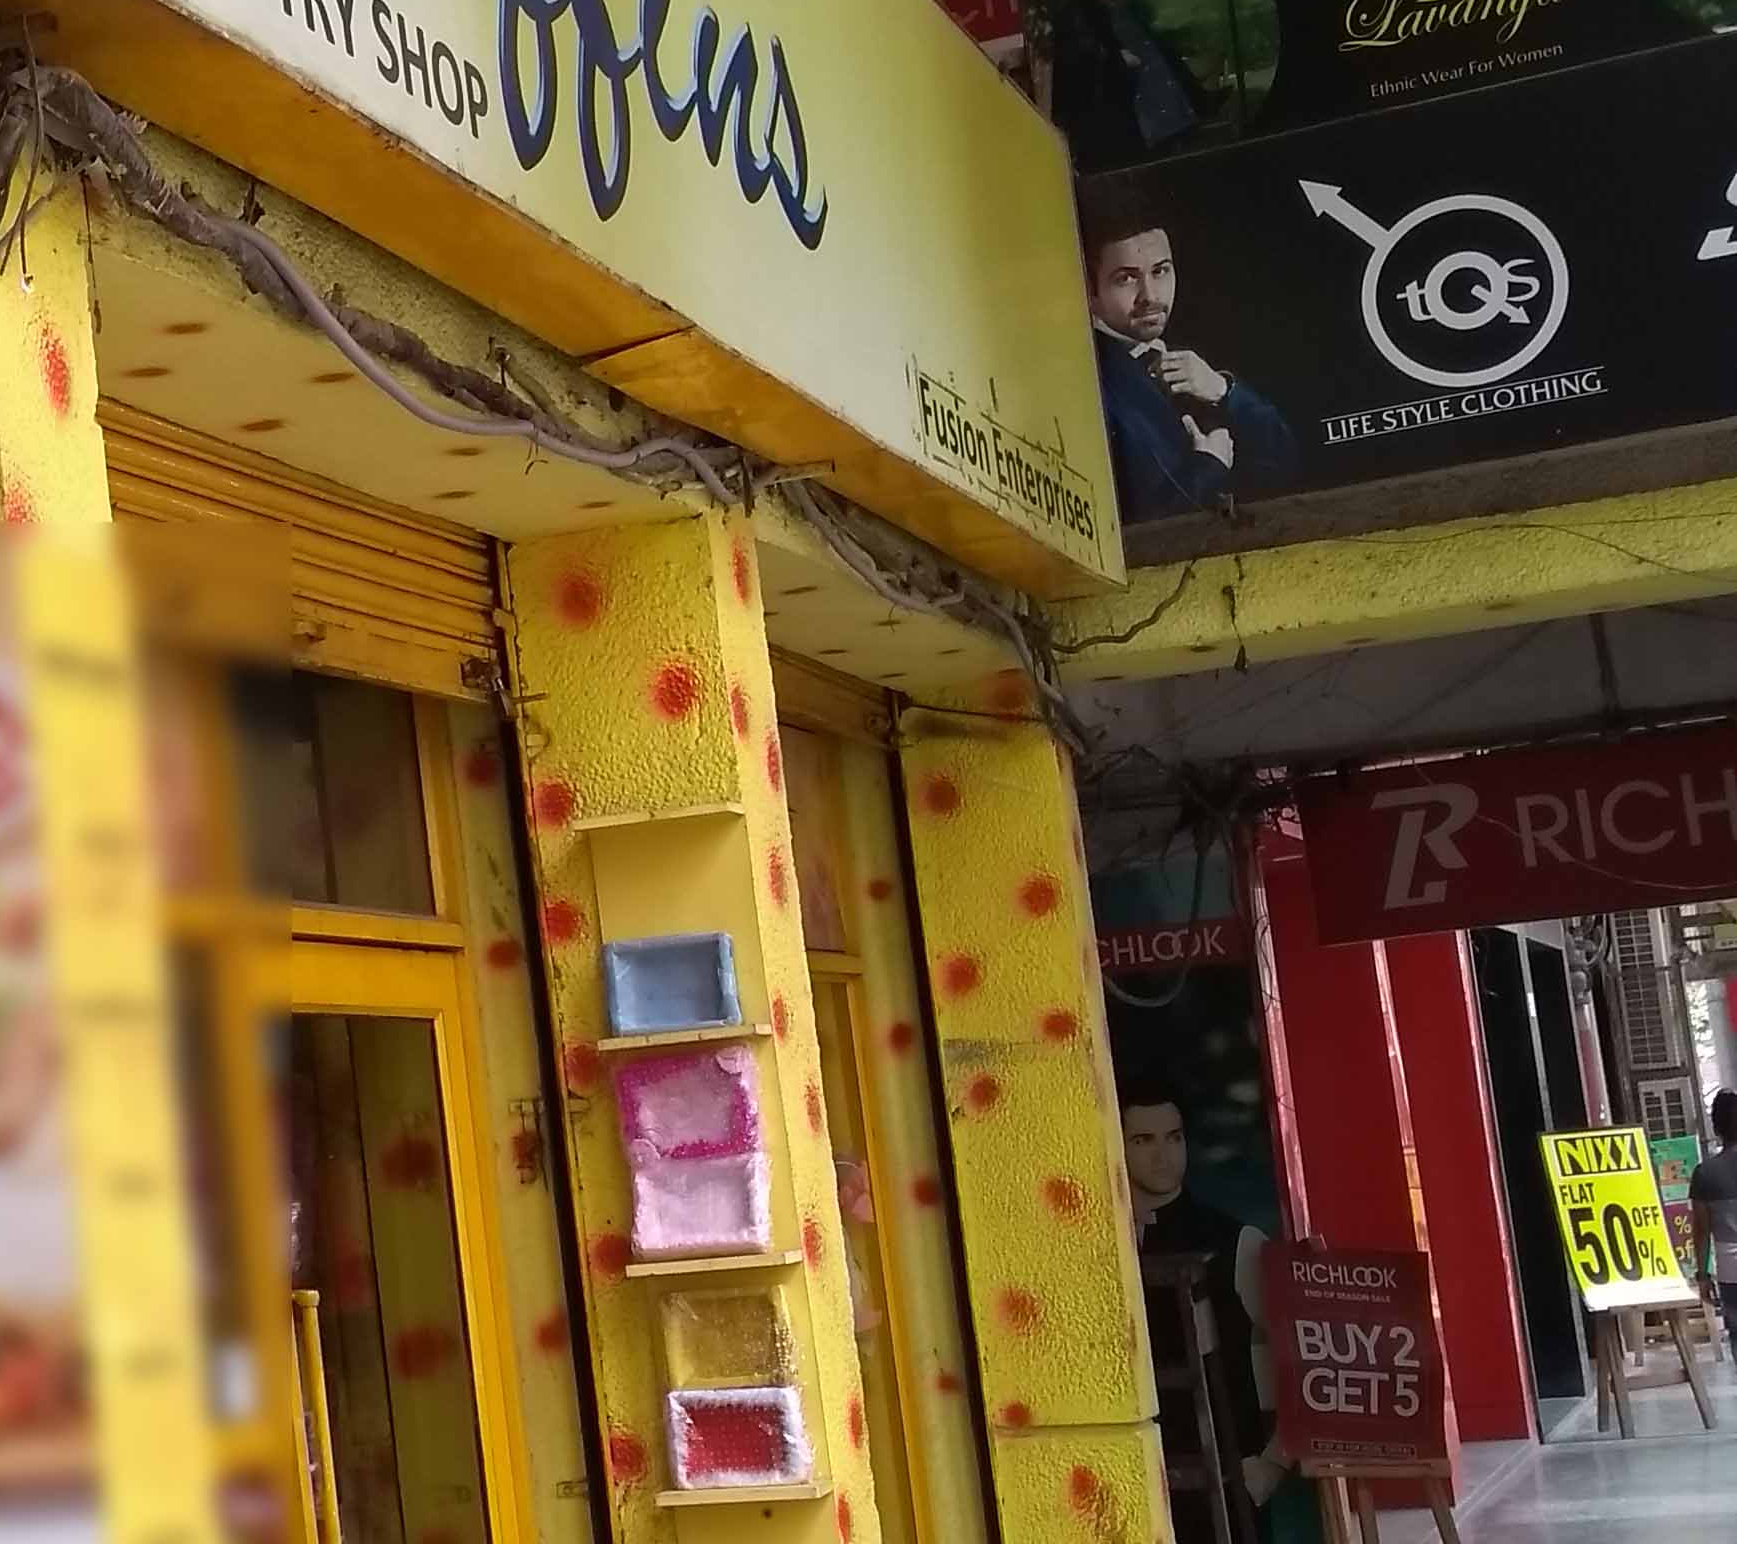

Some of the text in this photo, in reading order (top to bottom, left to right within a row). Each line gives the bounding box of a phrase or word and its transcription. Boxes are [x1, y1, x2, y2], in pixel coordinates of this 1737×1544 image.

[1369, 43, 1564, 98] Ethnic Wear For Women
[1325, 370, 1603, 442] LIFE STYLE CLOTHING
[918, 375, 1095, 541] Fusion Enterprises
[1555, 1134, 1640, 1176] NIXX
[1559, 1182, 1596, 1205] FLAT
[1631, 1205, 1660, 1228] OFF
[1567, 1202, 1644, 1286] 50
[1291, 1260, 1398, 1289] RICHLOOK
[1294, 1319, 1421, 1368] BUY 2
[1301, 1367, 1420, 1418] GET 5
